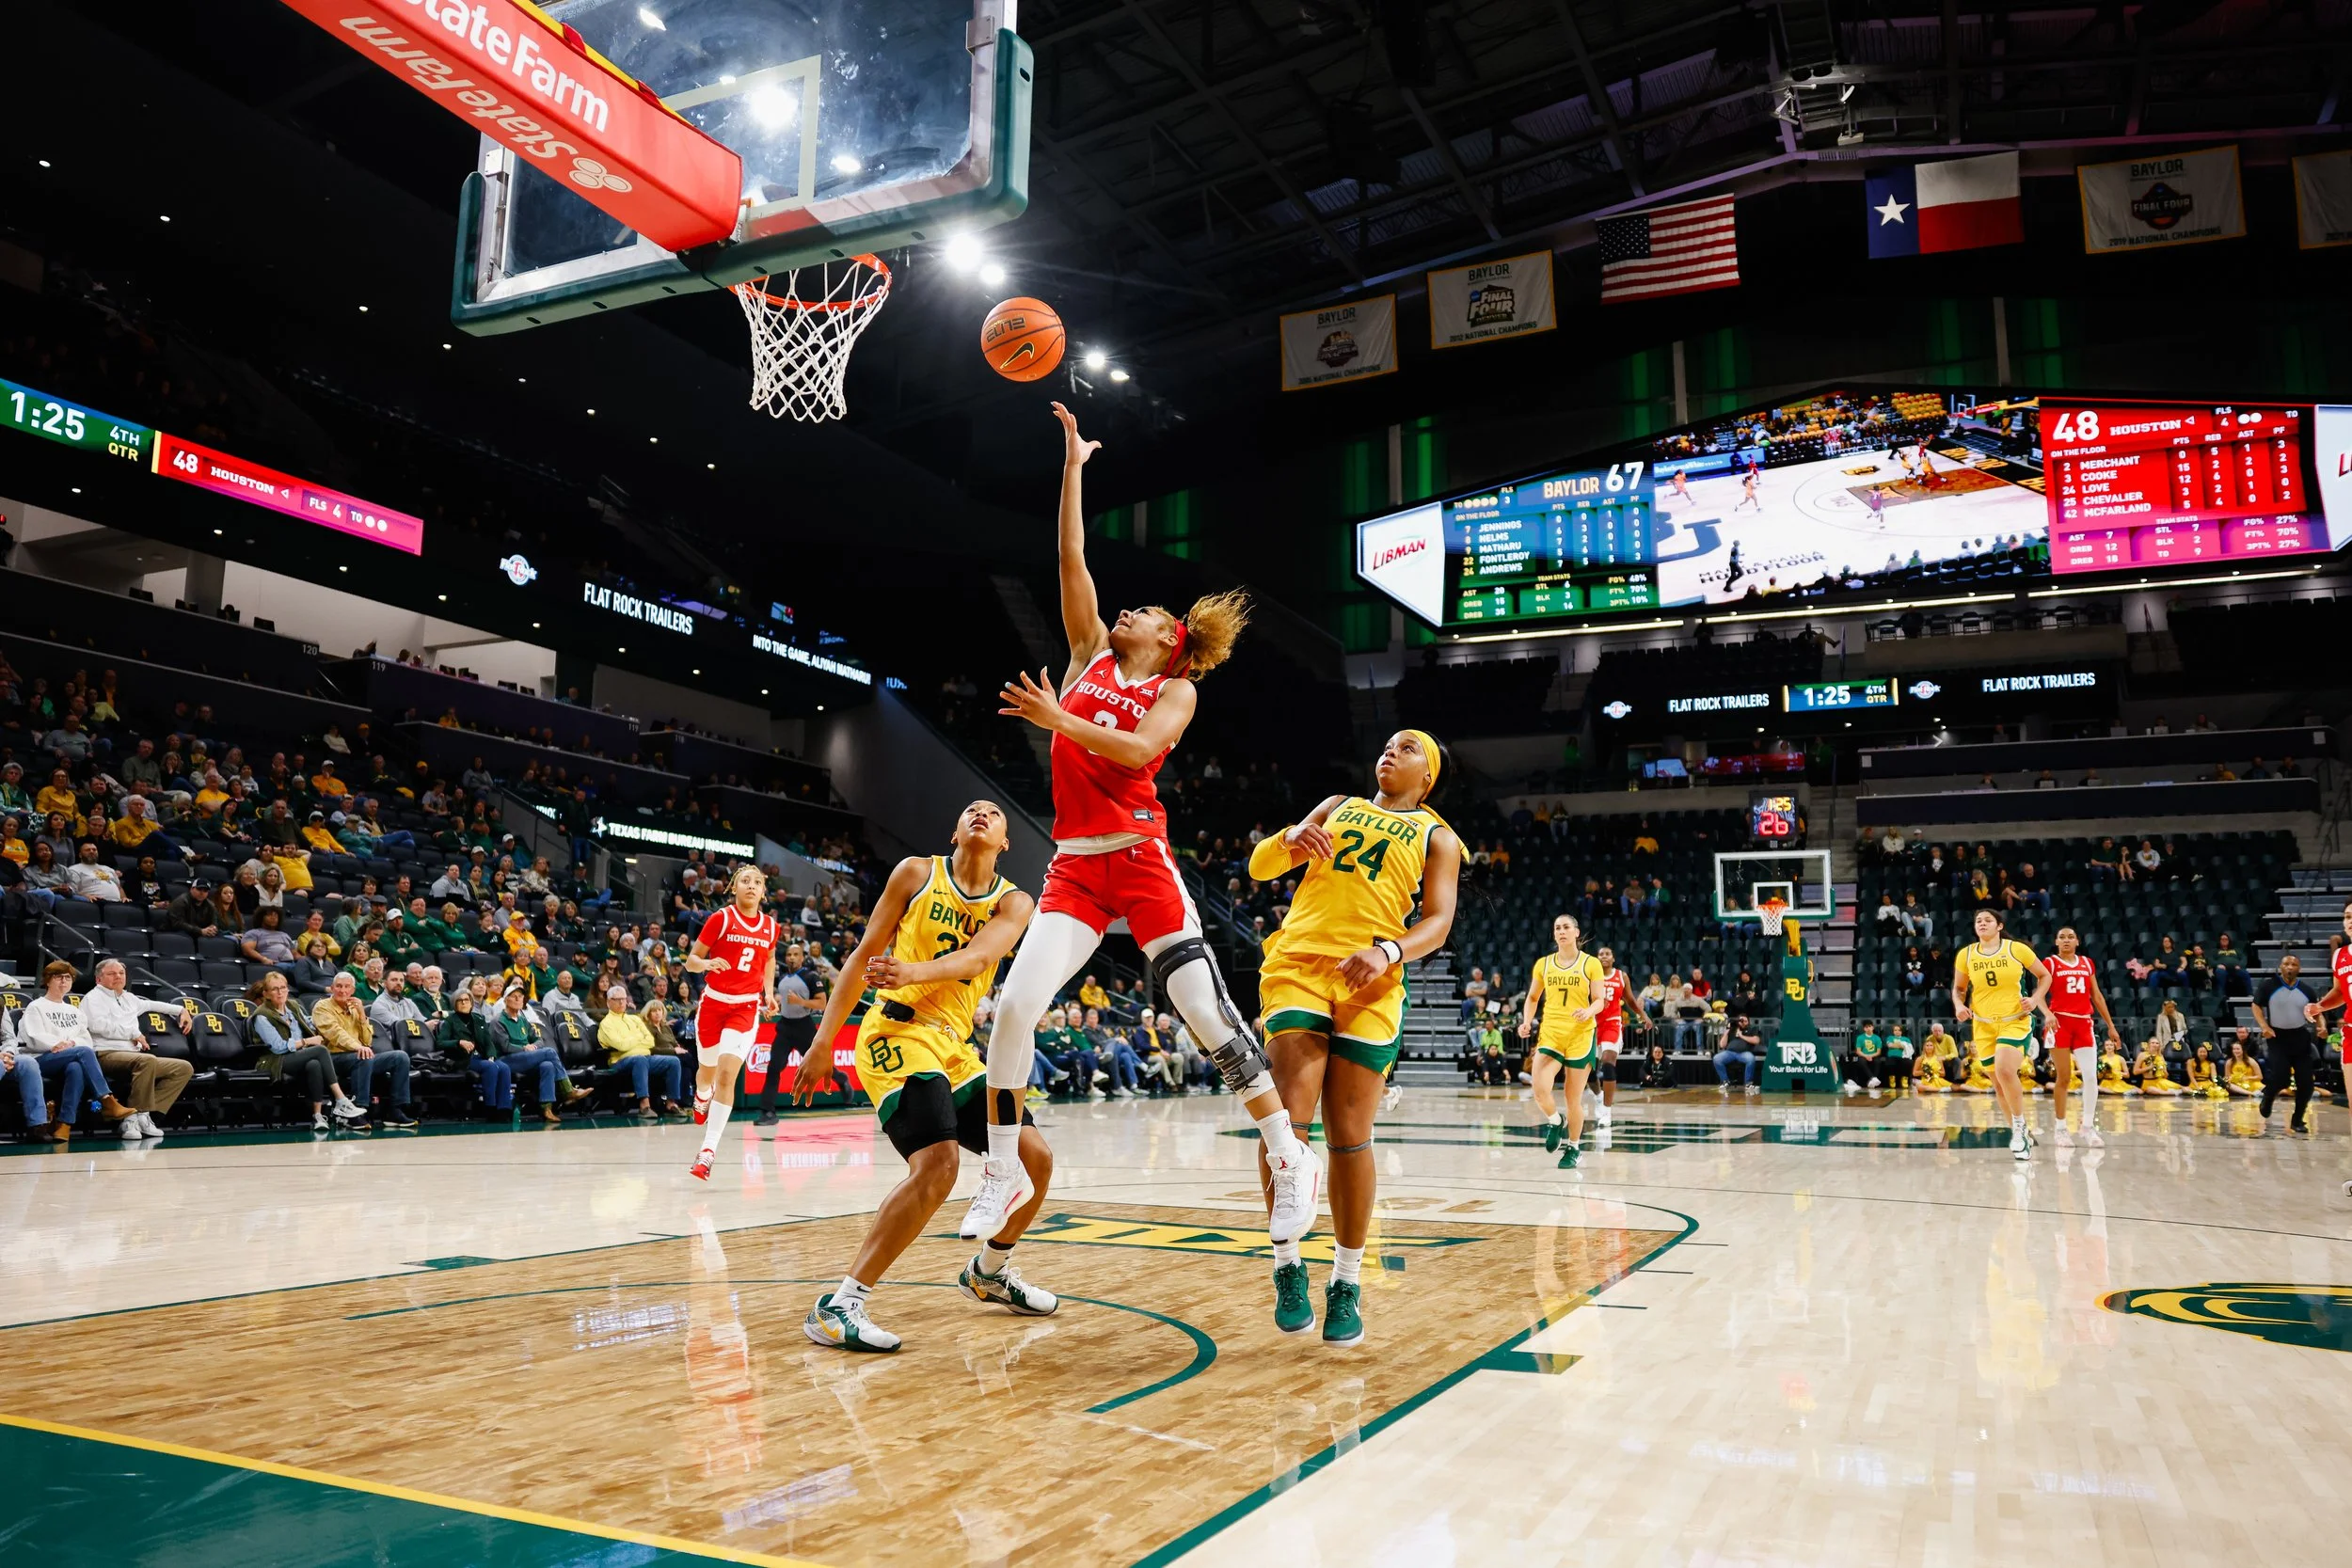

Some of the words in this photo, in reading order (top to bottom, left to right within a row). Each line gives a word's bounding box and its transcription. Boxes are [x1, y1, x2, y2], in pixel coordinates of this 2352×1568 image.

[2130, 159, 2184, 178] BAYLOR
[2133, 201, 2160, 214] FINAL
[2163, 198, 2191, 210] FOUR
[2128, 232, 2169, 245] NATIONAL
[1468, 263, 1510, 281] BAYLOR
[1481, 291, 1513, 303] FINAL
[1317, 307, 1356, 325] BAYLOR
[10, 390, 86, 441] 1:25
[2215, 406, 2232, 415] FLS
[2053, 410, 2100, 443] 48
[2109, 420, 2182, 436] HOUSTON
[2220, 418, 2229, 426] 4
[109, 425, 140, 446] 4TH
[2173, 436, 2190, 445] PTS
[2237, 430, 2254, 438] AST
[2273, 426, 2285, 435] PF
[108, 442, 139, 462] QTR
[2063, 448, 2079, 456] THE
[2080, 446, 2106, 454] FLOOR
[2063, 462, 2071, 471] 2
[2079, 455, 2140, 470] MERCHANT
[172, 450, 199, 474] 48
[210, 466, 275, 495] HOUSTON
[1543, 476, 1600, 499] BAYLOR
[1605, 461, 1645, 492] 67
[2064, 474, 2072, 483] 3
[2080, 470, 2118, 482] COOKE
[2062, 485, 2076, 495] 24
[2081, 483, 2110, 494] LOVE
[1551, 502, 1565, 511] PTS
[1602, 498, 1616, 506] AST
[2063, 498, 2076, 507] 25
[2082, 491, 2143, 506] CHEVALIER
[309, 497, 327, 512] FLS
[332, 504, 342, 518] 4
[350, 511, 363, 523] TO
[2064, 509, 2077, 518] 42
[2084, 502, 2152, 517] MCFARLAND
[1479, 519, 1522, 532] JENNINGS
[2276, 515, 2297, 524] 27%
[1478, 532, 1509, 543] HELMS
[2069, 533, 2085, 542] AST
[2245, 530, 2265, 538] FT%
[2277, 527, 2298, 536] 70%
[1479, 541, 1521, 553] MATHARU
[2105, 543, 2118, 551] 12
[2278, 539, 2300, 548] 27%
[1373, 538, 1426, 571] LIBMAN
[1463, 556, 1474, 566] 22
[1479, 551, 1530, 564] FONTLEROY
[1479, 562, 1523, 575] ANDREWS
[1463, 589, 1477, 597] AST
[1609, 587, 1625, 595] FT%
[1629, 584, 1647, 594] 70%
[1495, 596, 1505, 605] 15
[1631, 595, 1648, 604] 10%
[584, 581, 612, 610] FLAT
[612, 592, 643, 620] ROCK
[644, 601, 693, 635] TRAILERS
[302, 643, 318, 656] 120
[753, 634, 771, 652] INTO
[771, 641, 787, 657] THE
[787, 646, 811, 668] GAME,
[811, 655, 836, 673] ALIYAH
[372, 661, 386, 672] 119
[1865, 684, 1887, 695] 4TH
[1982, 677, 2010, 692] FLAT
[2010, 675, 2042, 690] ROCK
[2042, 673, 2096, 689] TRAILERS
[1075, 680, 1148, 720] HOUSTO
[1668, 698, 1693, 713] FLAT
[1694, 696, 1722, 711] ROCK
[1723, 693, 1770, 708] TRAILERS
[1804, 684, 1851, 706] 1:25
[1867, 694, 1887, 704] QTR
[628, 723, 640, 732] 119
[1335, 811, 1418, 847] BAYLOR
[1759, 812, 1789, 835] 26
[609, 822, 641, 840] TEXAS
[641, 827, 667, 845] FARM
[667, 832, 706, 851] BUREAU
[706, 838, 755, 858] INSURANCE
[1332, 829, 1391, 882] 24
[929, 901, 987, 937] BAYLO
[726, 933, 771, 949] HOUSTON
[737, 947, 755, 973] 2
[1973, 959, 2009, 972] BAYLOR
[1985, 971, 1998, 987] 8
[2056, 969, 2090, 977] HOUSTON
[1548, 976, 1581, 987] BAYLOR
[1786, 977, 1805, 1002] BU
[2066, 976, 2086, 994] 24
[1558, 988, 1568, 1006] 7
[183, 998, 199, 1017] BU
[234, 1001, 250, 1018] BU
[148, 1012, 167, 1033] BU
[205, 1014, 224, 1033] BU
[405, 1019, 421, 1037] BU
[867, 1036, 904, 1073] BU
[1786, 1065, 1804, 1073] Bank
[1804, 1065, 1815, 1073] for
[1815, 1066, 1828, 1074] Life
